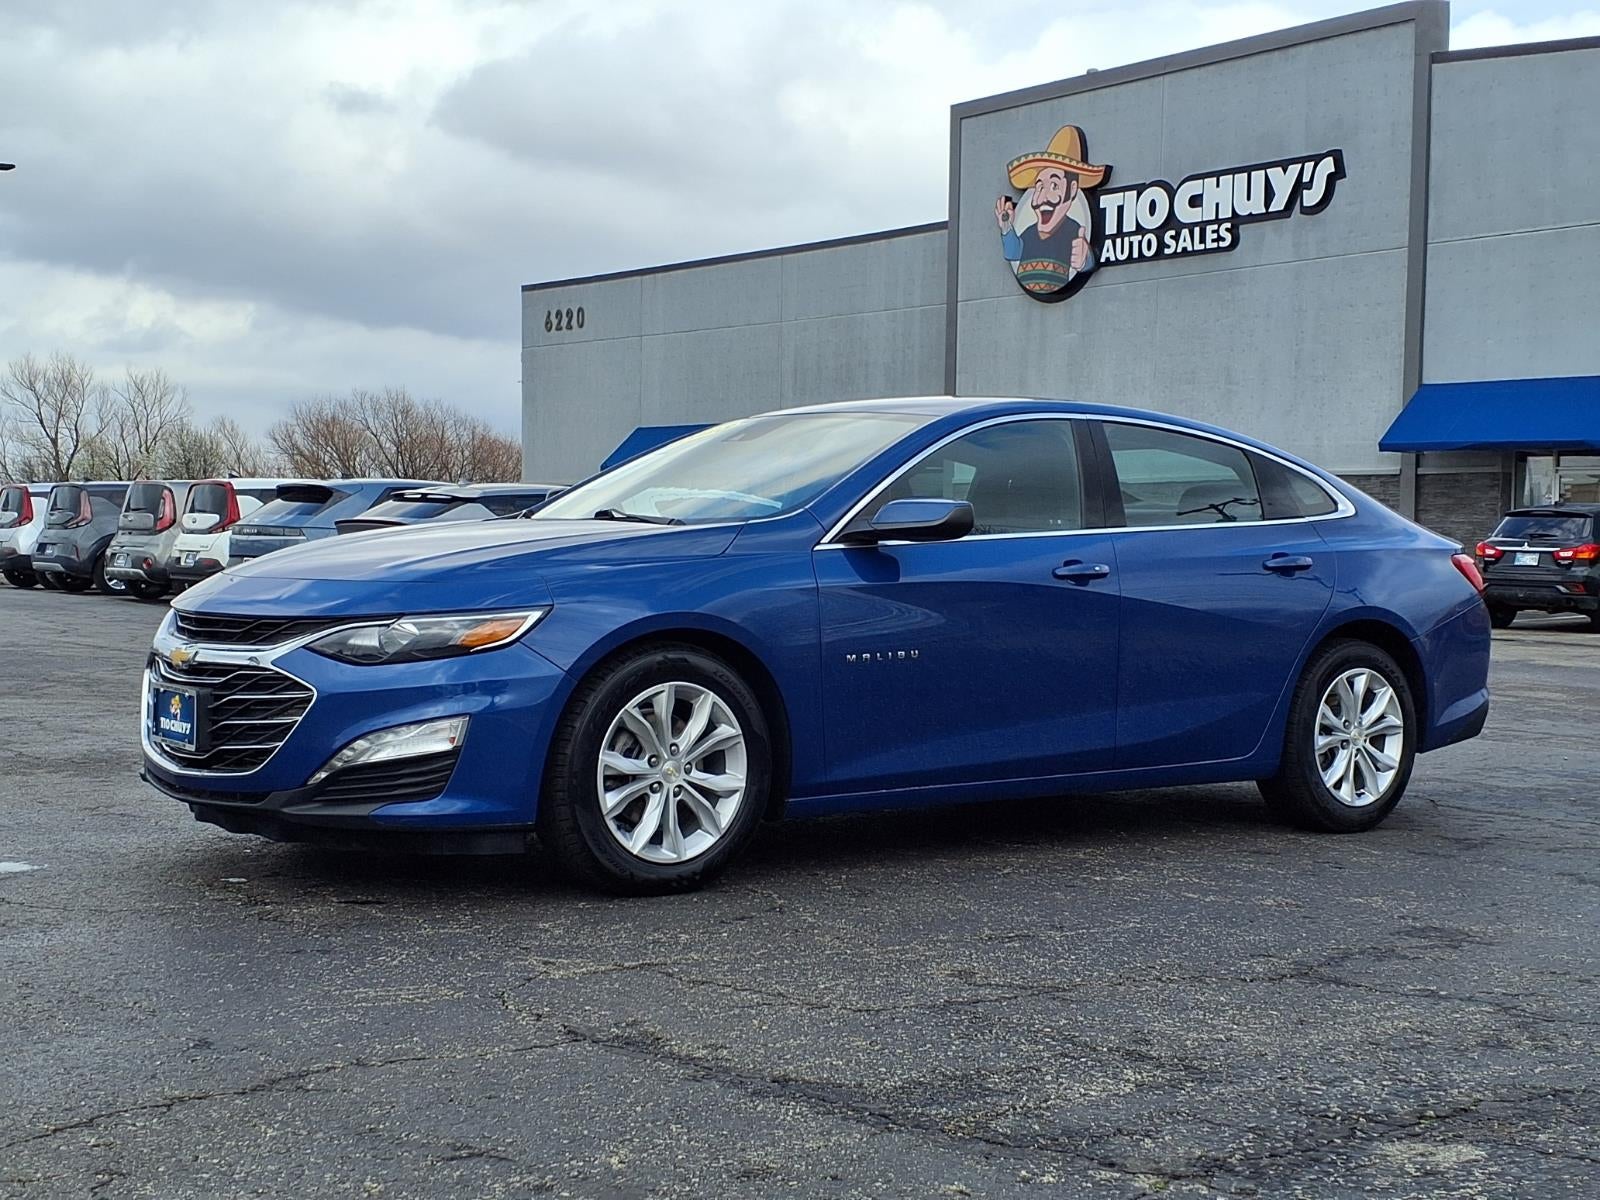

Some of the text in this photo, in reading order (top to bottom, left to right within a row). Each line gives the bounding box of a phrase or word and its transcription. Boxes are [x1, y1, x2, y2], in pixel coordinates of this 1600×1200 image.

[1100, 156, 1335, 235] TIO CHUY'S
[1100, 222, 1232, 263] AUTO SALES
[544, 306, 585, 333] 6220
[846, 650, 919, 663] MALIBU
